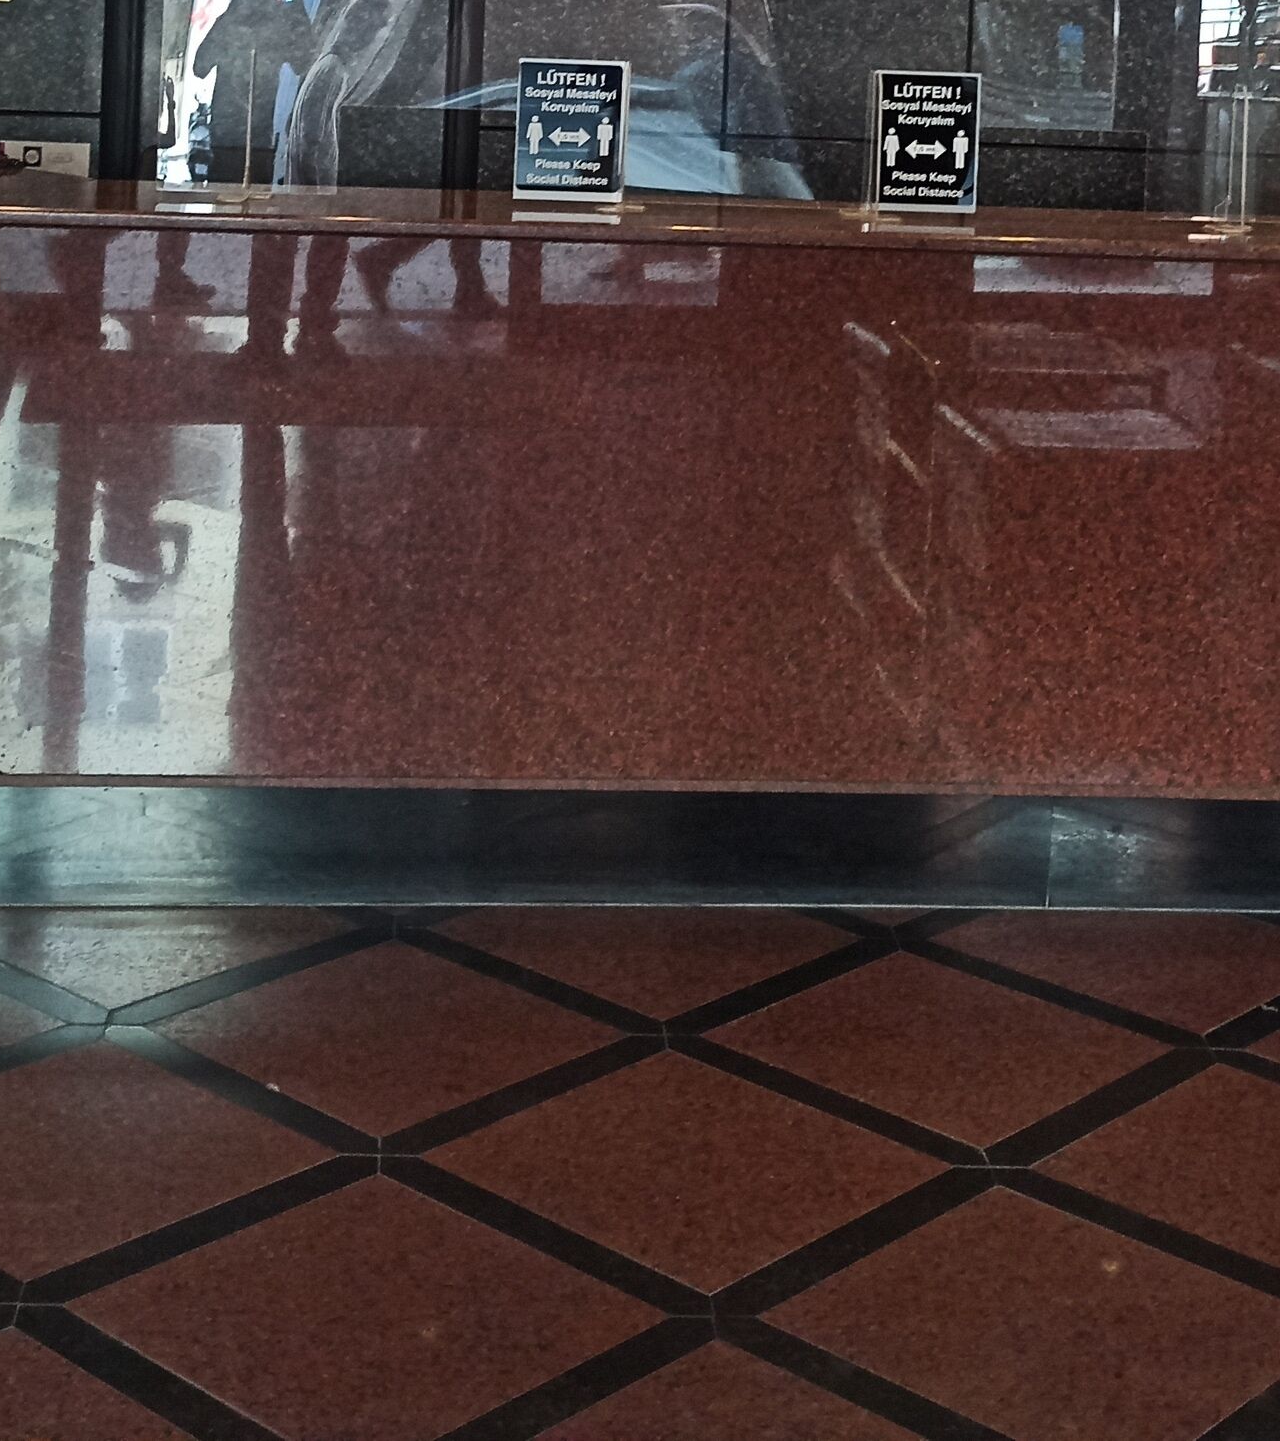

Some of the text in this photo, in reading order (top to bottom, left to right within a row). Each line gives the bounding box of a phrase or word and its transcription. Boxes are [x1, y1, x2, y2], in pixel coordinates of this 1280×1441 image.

[537, 69, 597, 86] LÜTFEN
[525, 87, 617, 102] Sosyal Mesafeyi
[893, 82, 953, 99] LÜTFEN
[541, 101, 599, 115] Koruyalım
[881, 99, 973, 116] Sosyal Mesafeyi
[897, 114, 955, 128] Koruyalım
[535, 159, 601, 173] Please Keep
[526, 173, 608, 186] Social Distance
[891, 171, 957, 186] Please Keep
[883, 185, 965, 198] Social Distance
